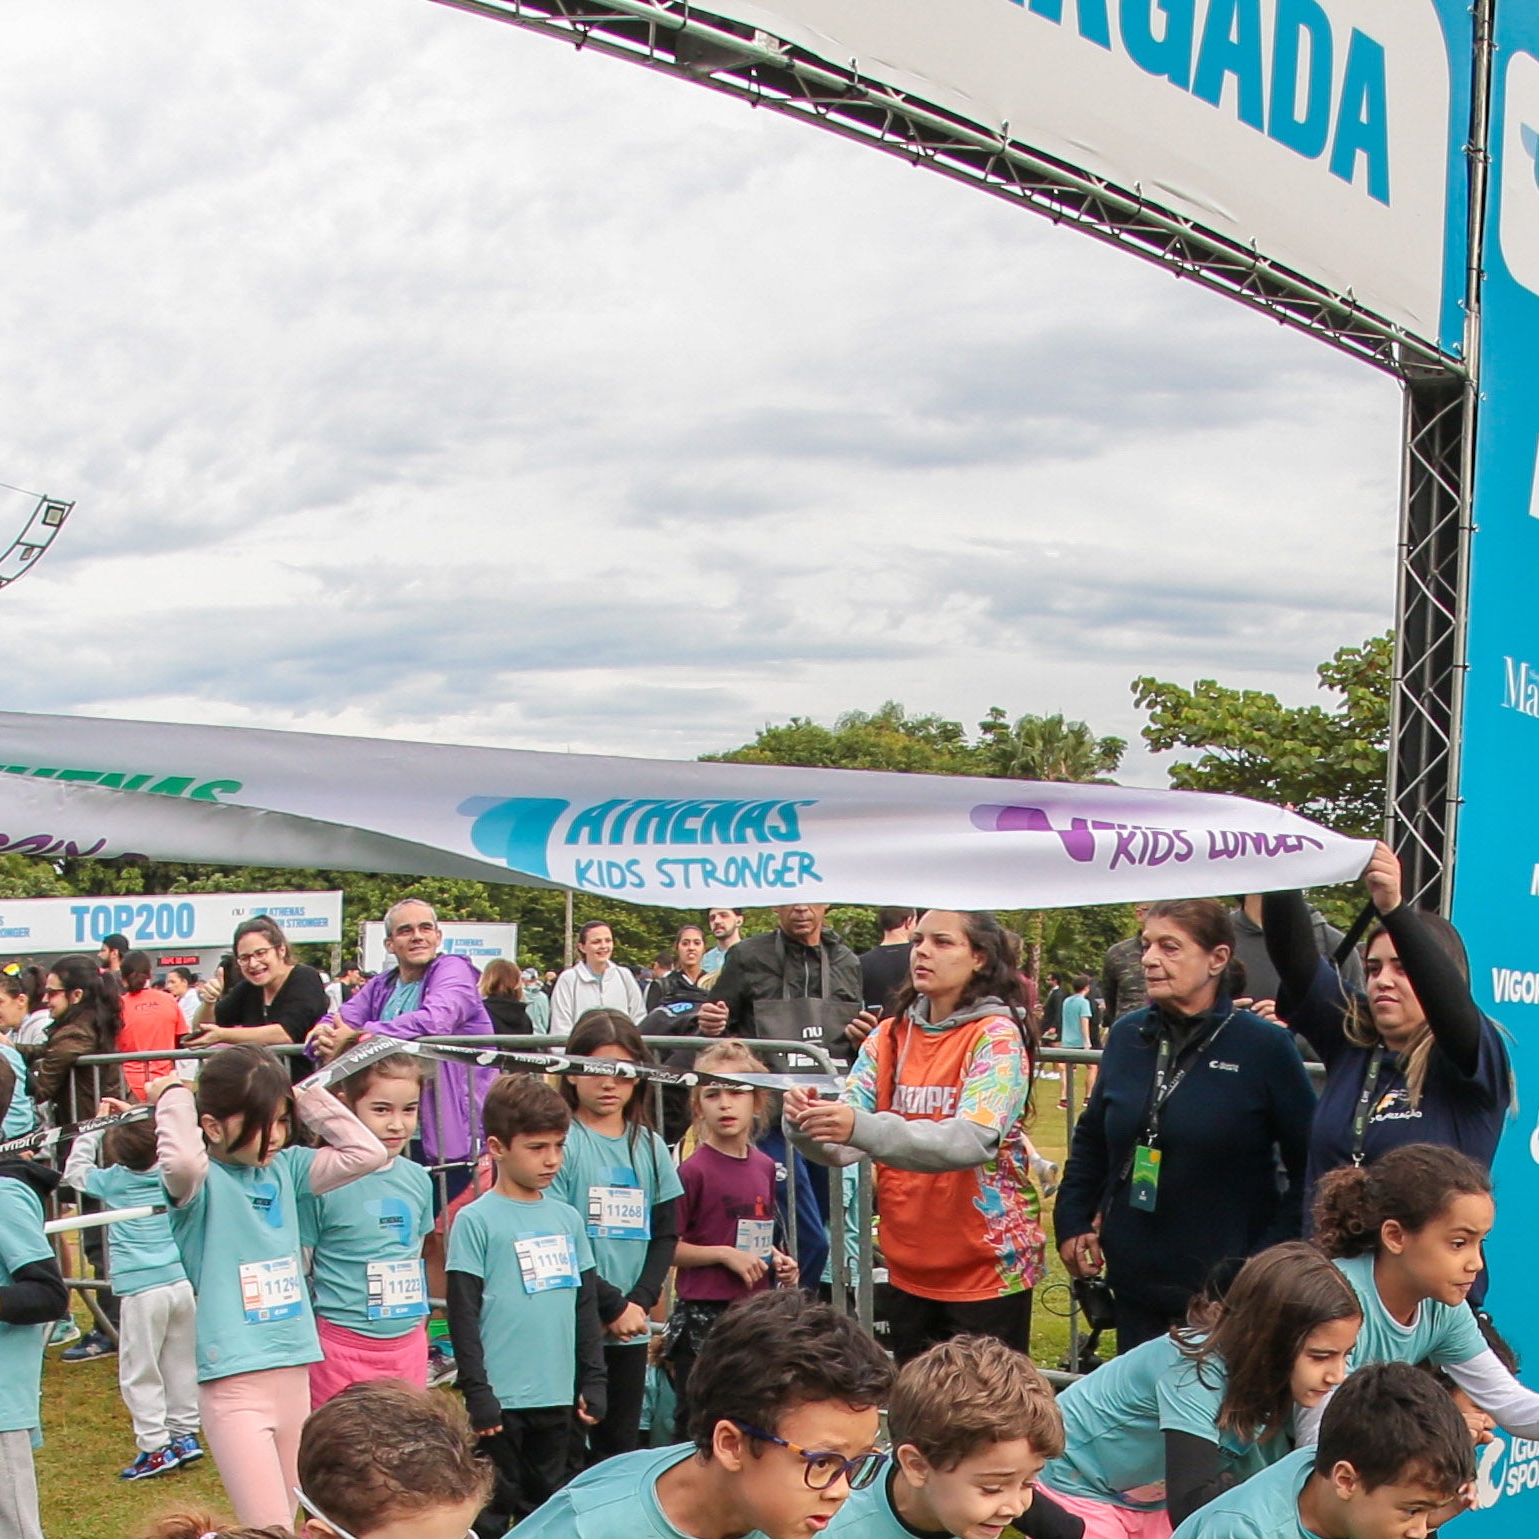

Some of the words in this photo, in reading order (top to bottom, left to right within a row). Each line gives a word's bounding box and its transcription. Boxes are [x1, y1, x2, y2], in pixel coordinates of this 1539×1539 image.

[1007, 0, 1390, 208] GADA
[564, 798, 820, 845] ATHENAS
[1109, 830, 1194, 870] KIDS
[576, 858, 646, 888] KIDS
[656, 852, 823, 888] STRONGER
[70, 903, 195, 942] TOP200
[607, 1204, 642, 1218] 11268
